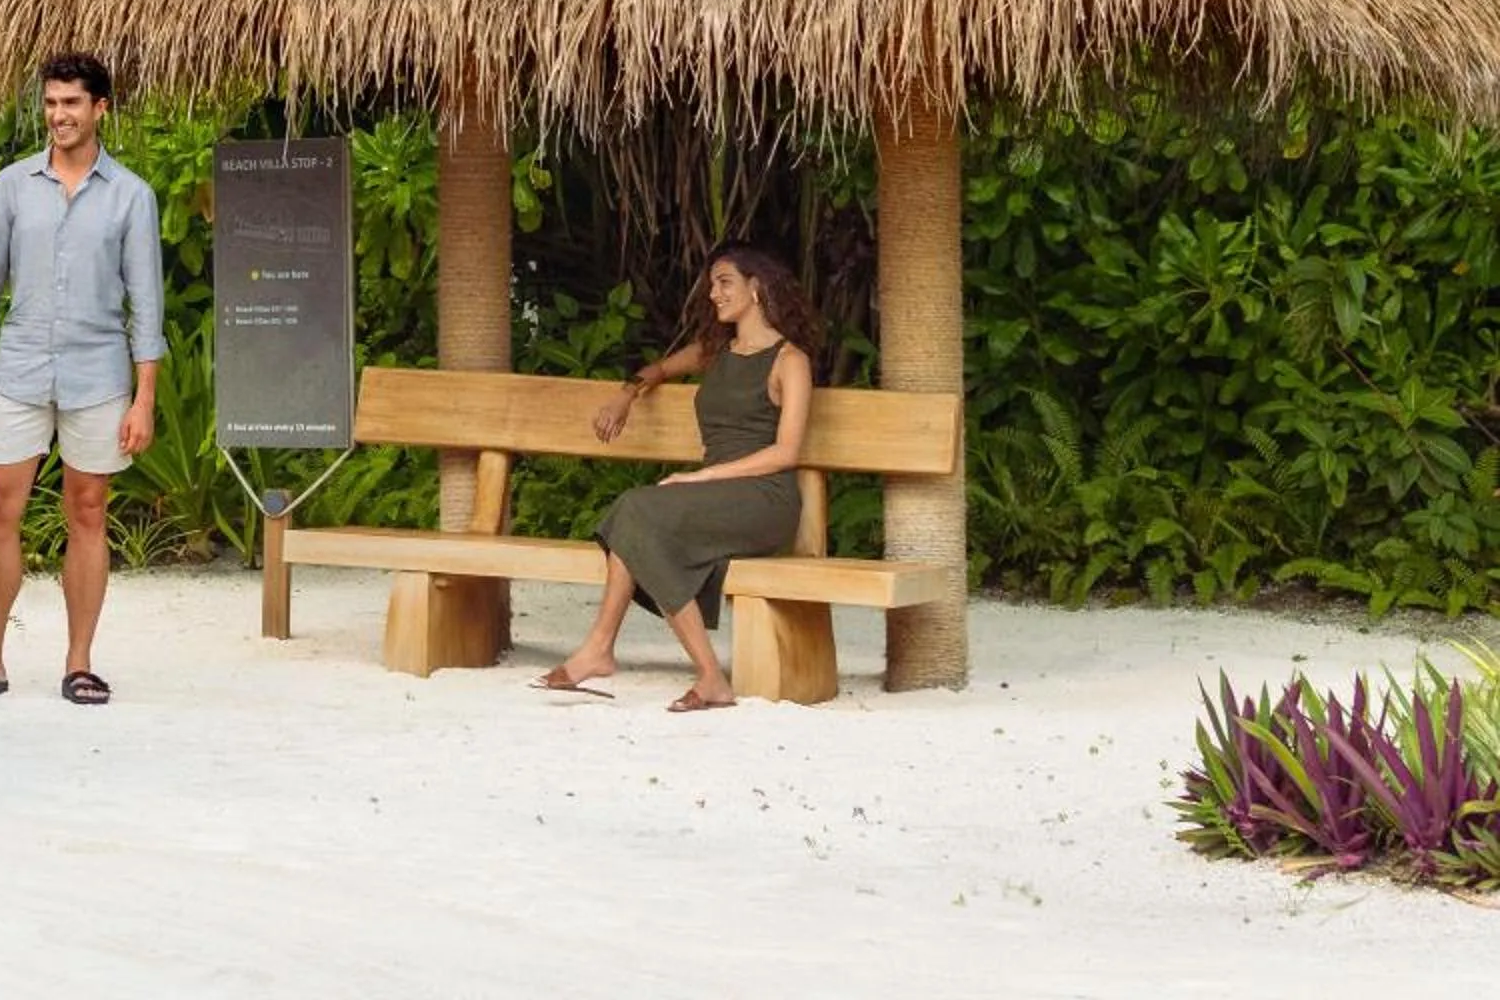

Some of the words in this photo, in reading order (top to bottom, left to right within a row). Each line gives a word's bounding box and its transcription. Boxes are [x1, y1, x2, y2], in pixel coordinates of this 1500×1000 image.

[221, 159, 257, 171] BEACH
[260, 159, 289, 170] VILLA
[292, 157, 317, 169] STOP
